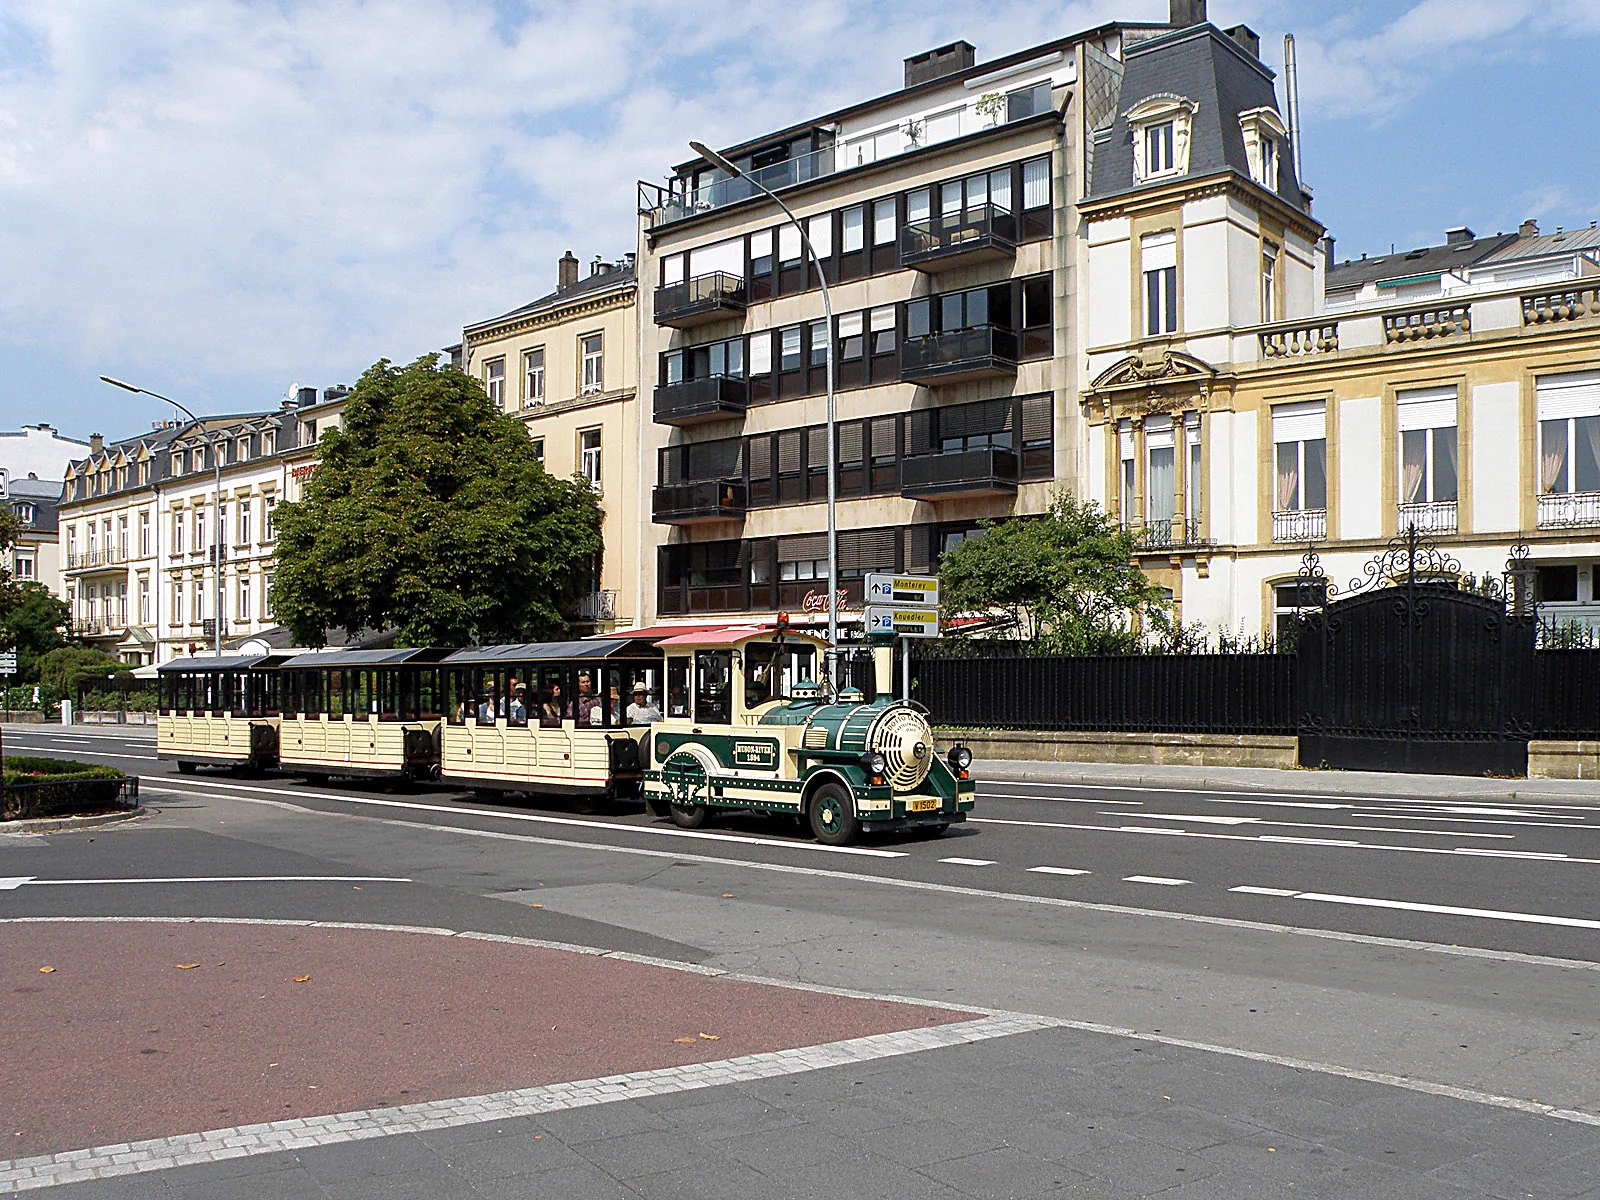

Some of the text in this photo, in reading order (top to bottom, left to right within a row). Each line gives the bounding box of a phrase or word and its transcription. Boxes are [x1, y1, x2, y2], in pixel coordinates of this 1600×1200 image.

[893, 580, 927, 590] Monterey
[803, 589, 849, 613] Coca-Cla
[893, 612, 925, 621] Knuedler
